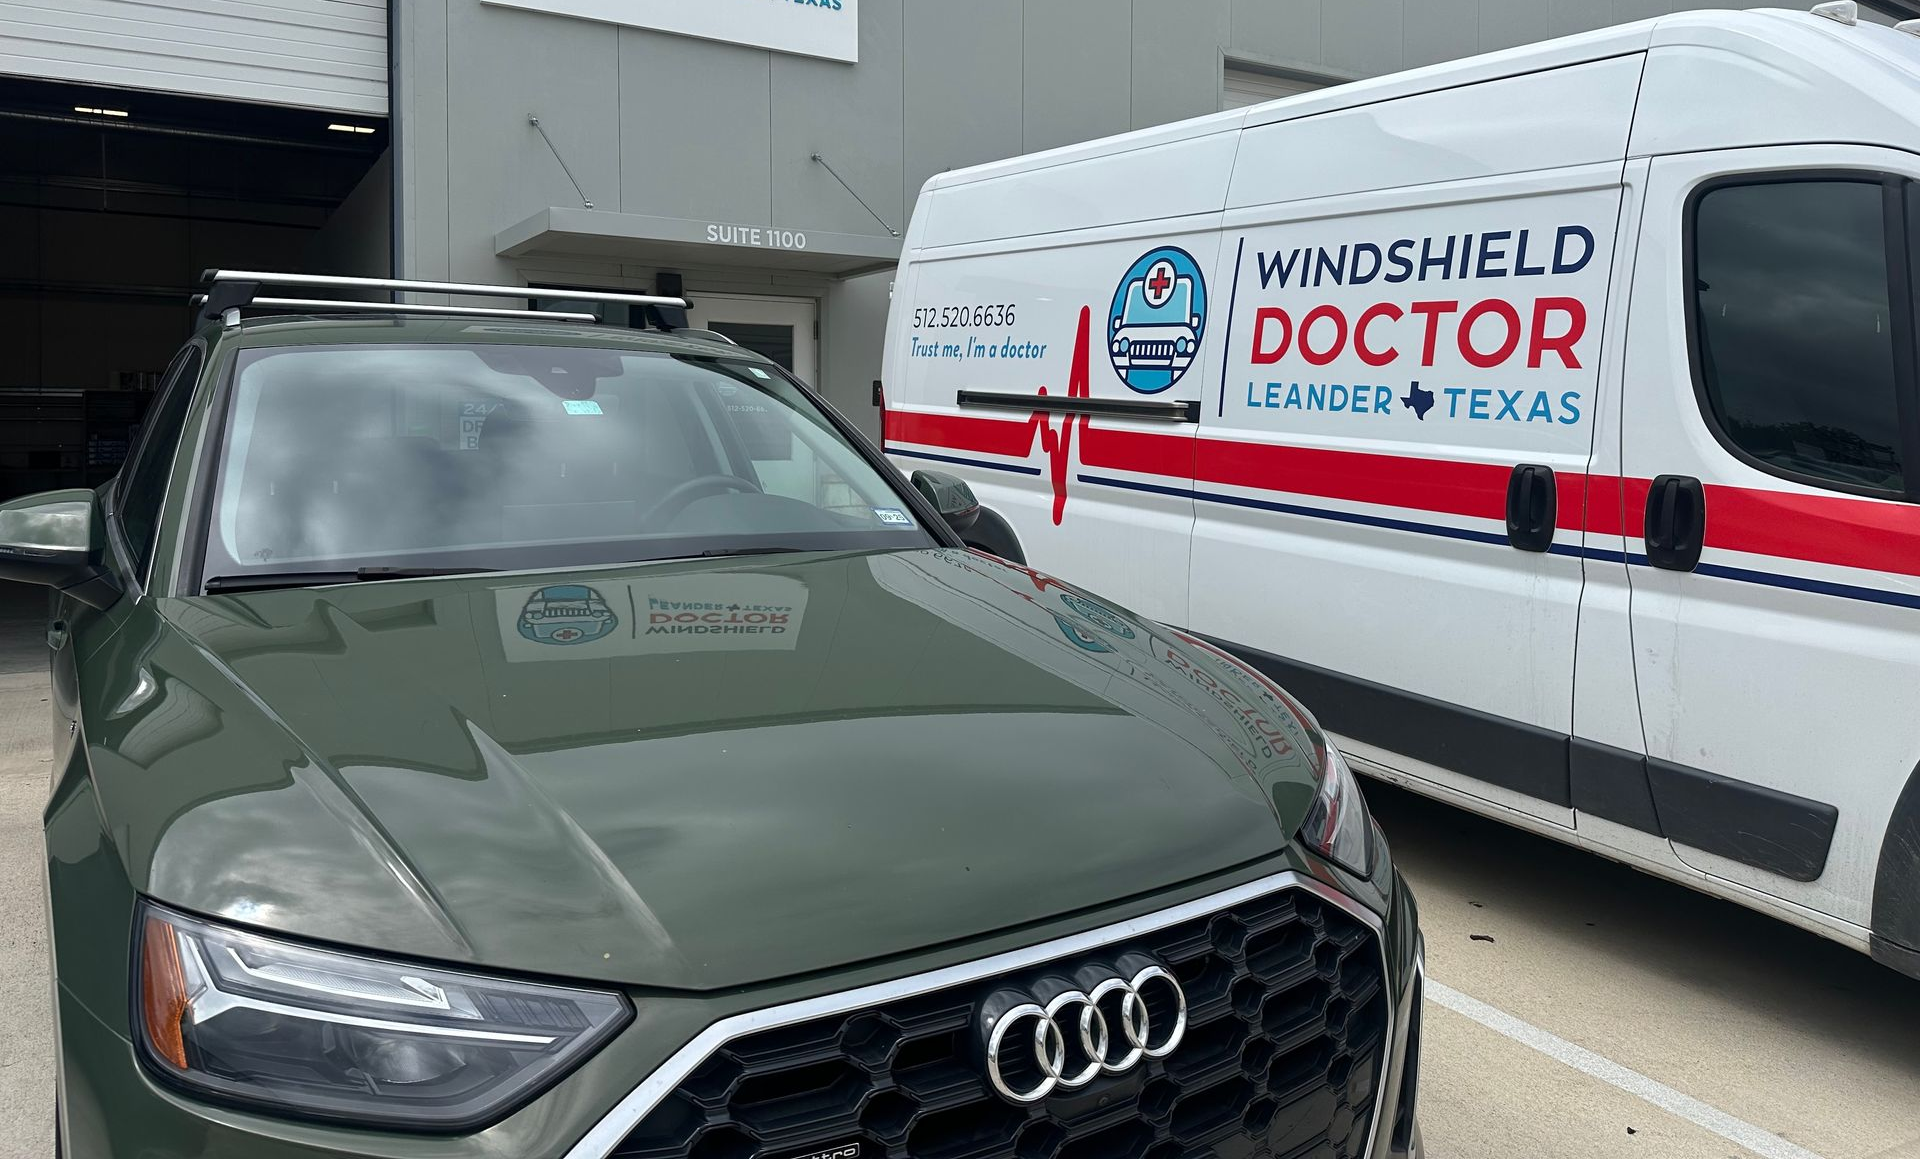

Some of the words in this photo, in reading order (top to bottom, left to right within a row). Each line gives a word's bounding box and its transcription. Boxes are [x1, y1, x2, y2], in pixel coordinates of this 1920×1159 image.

[707, 224, 761, 246] SUITE
[766, 229, 806, 249] 1100
[1257, 225, 1595, 289] WINDSHIELD
[913, 304, 1016, 328] 512.520.6636
[1250, 296, 1587, 369] DOCTOR
[911, 337, 939, 357] Trust
[942, 344, 963, 362] me,
[966, 336, 985, 358] I'm
[989, 344, 997, 358] a
[1000, 336, 1047, 358] doctor
[1247, 381, 1392, 415] LEANDER
[1443, 388, 1581, 425] TEXAS
